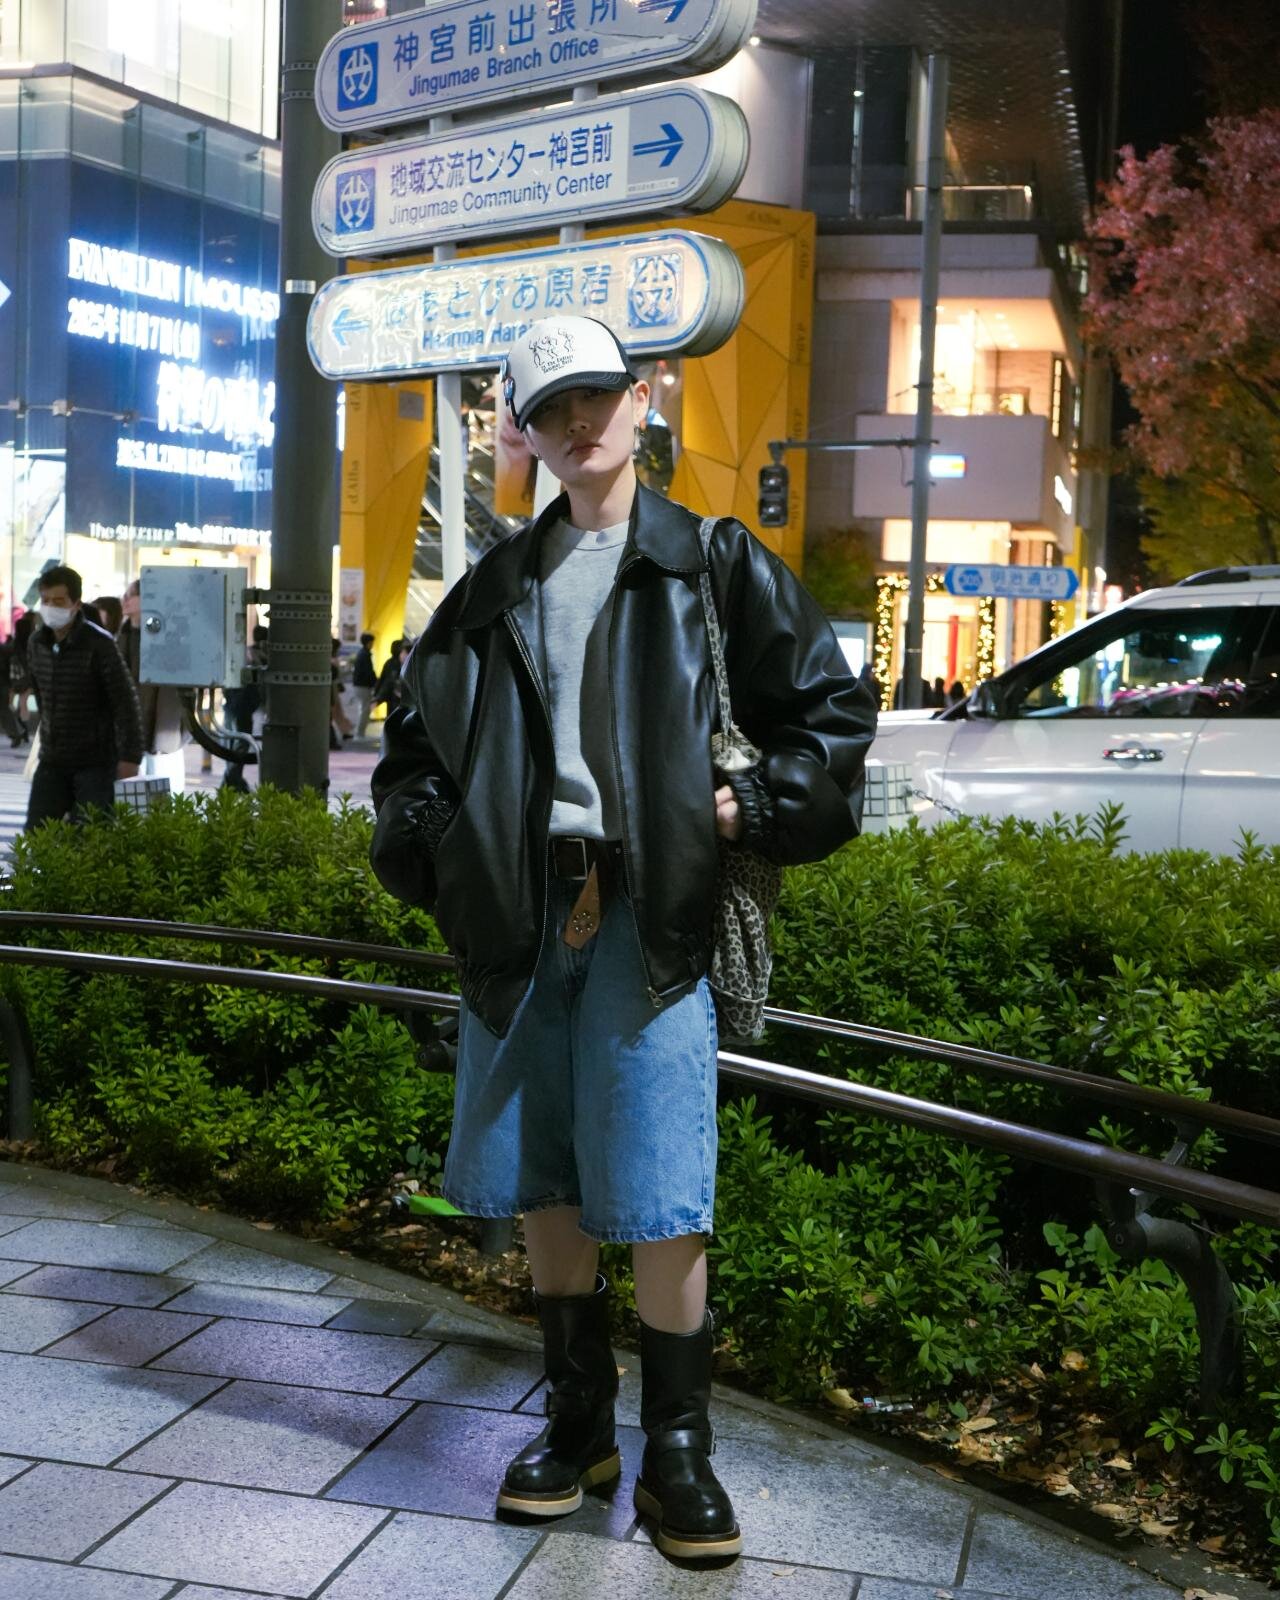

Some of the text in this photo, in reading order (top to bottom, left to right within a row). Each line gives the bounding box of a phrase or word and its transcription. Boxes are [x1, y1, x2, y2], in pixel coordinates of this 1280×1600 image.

[408, 37, 599, 97] Jingumae Branch Office
[389, 121, 613, 198] 地域交流センター神宮前
[389, 169, 613, 226] Jingumae Community Center
